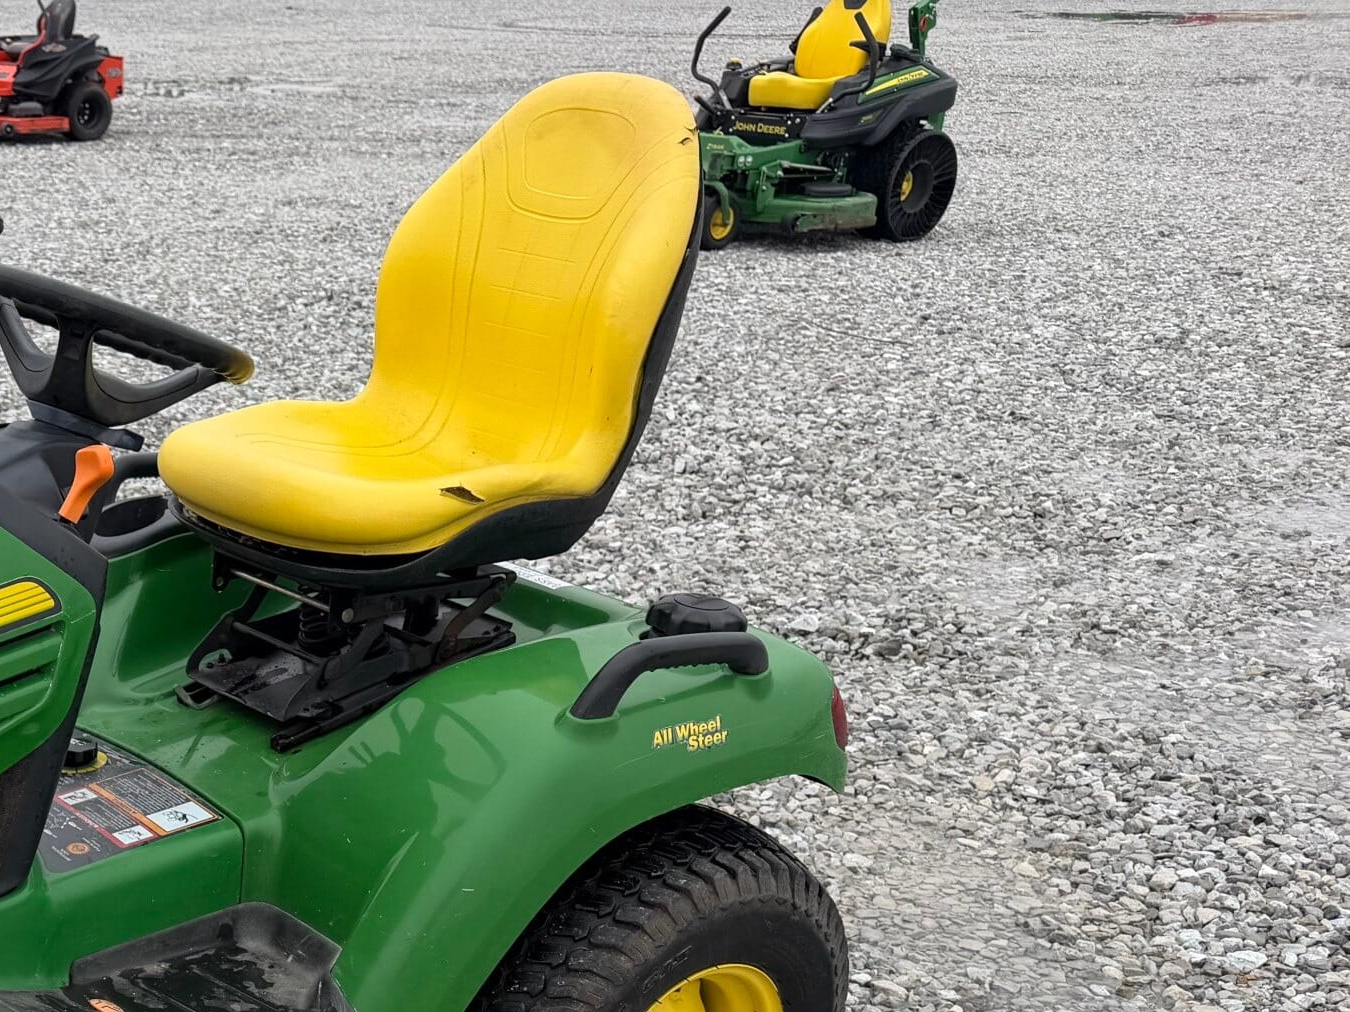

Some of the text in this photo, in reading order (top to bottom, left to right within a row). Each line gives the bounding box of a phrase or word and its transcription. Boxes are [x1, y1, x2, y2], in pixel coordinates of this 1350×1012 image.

[733, 121, 787, 135] JOHN DEERE
[653, 715, 721, 748] All Wheel
[687, 729, 728, 752] Steer
